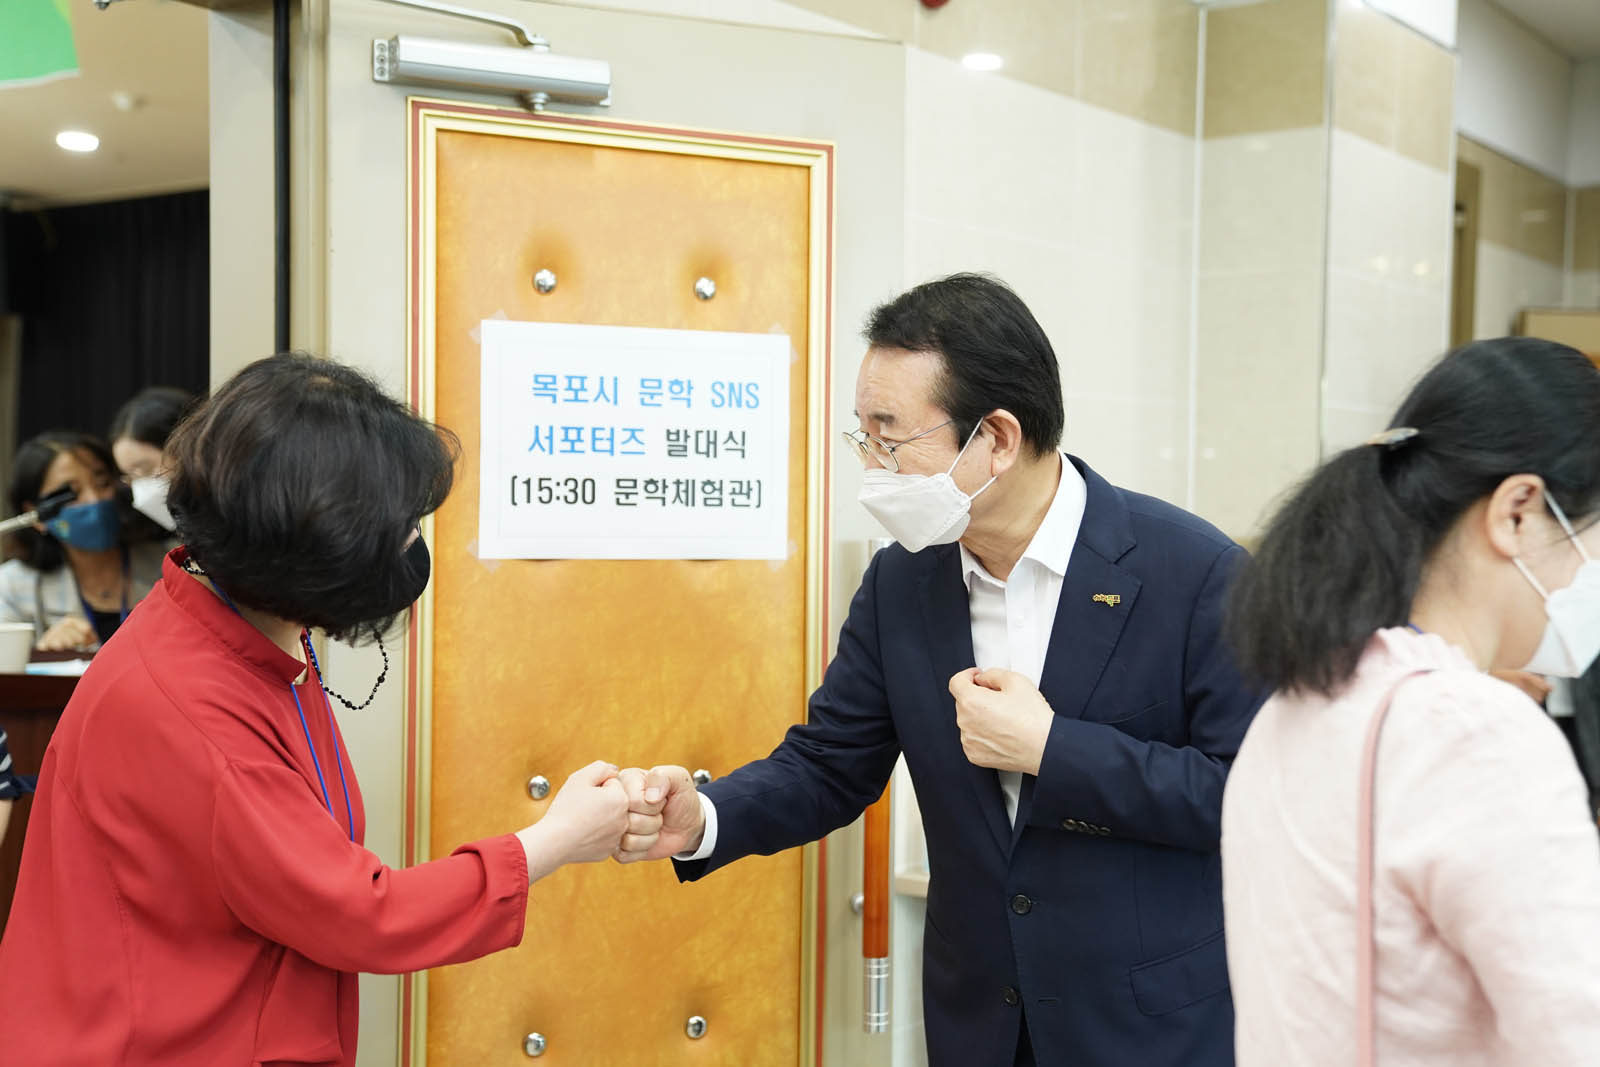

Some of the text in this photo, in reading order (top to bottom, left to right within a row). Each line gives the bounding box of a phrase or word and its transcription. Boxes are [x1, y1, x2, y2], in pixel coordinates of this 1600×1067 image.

[531, 373, 760, 409] 목포시 문학 SNS
[527, 425, 748, 459] 서포터즈 발대식
